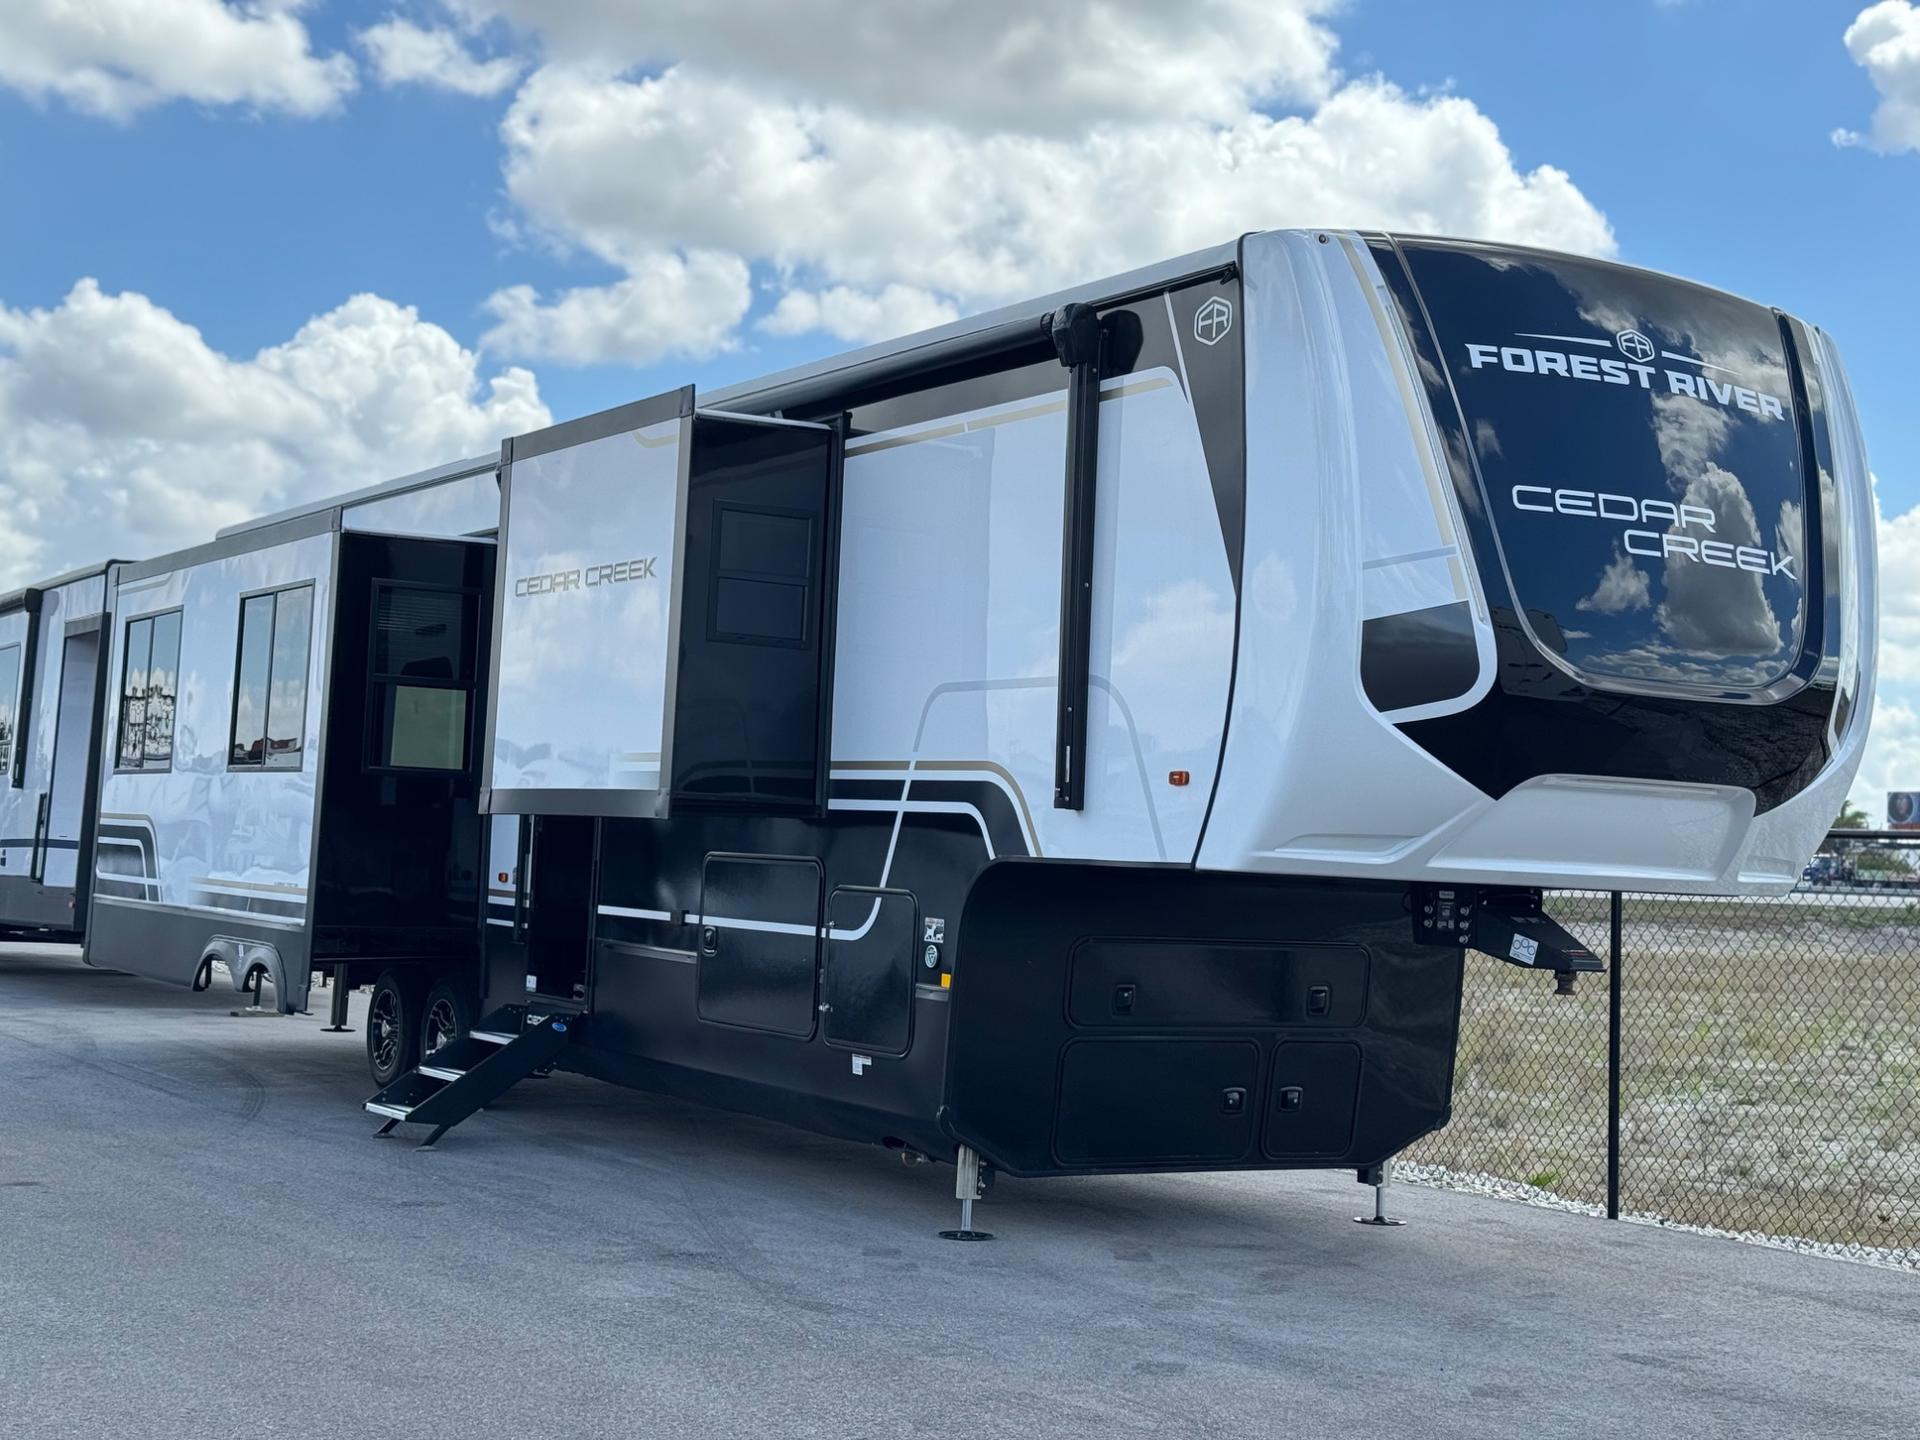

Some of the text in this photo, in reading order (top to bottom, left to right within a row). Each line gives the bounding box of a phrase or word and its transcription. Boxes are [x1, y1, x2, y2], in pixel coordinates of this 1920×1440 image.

[1464, 343, 1785, 421] FOREST RIVER
[1512, 484, 1716, 533] CEDAR
[515, 556, 658, 597] CEDAR CREEK
[1624, 529, 1798, 580] CREEK
